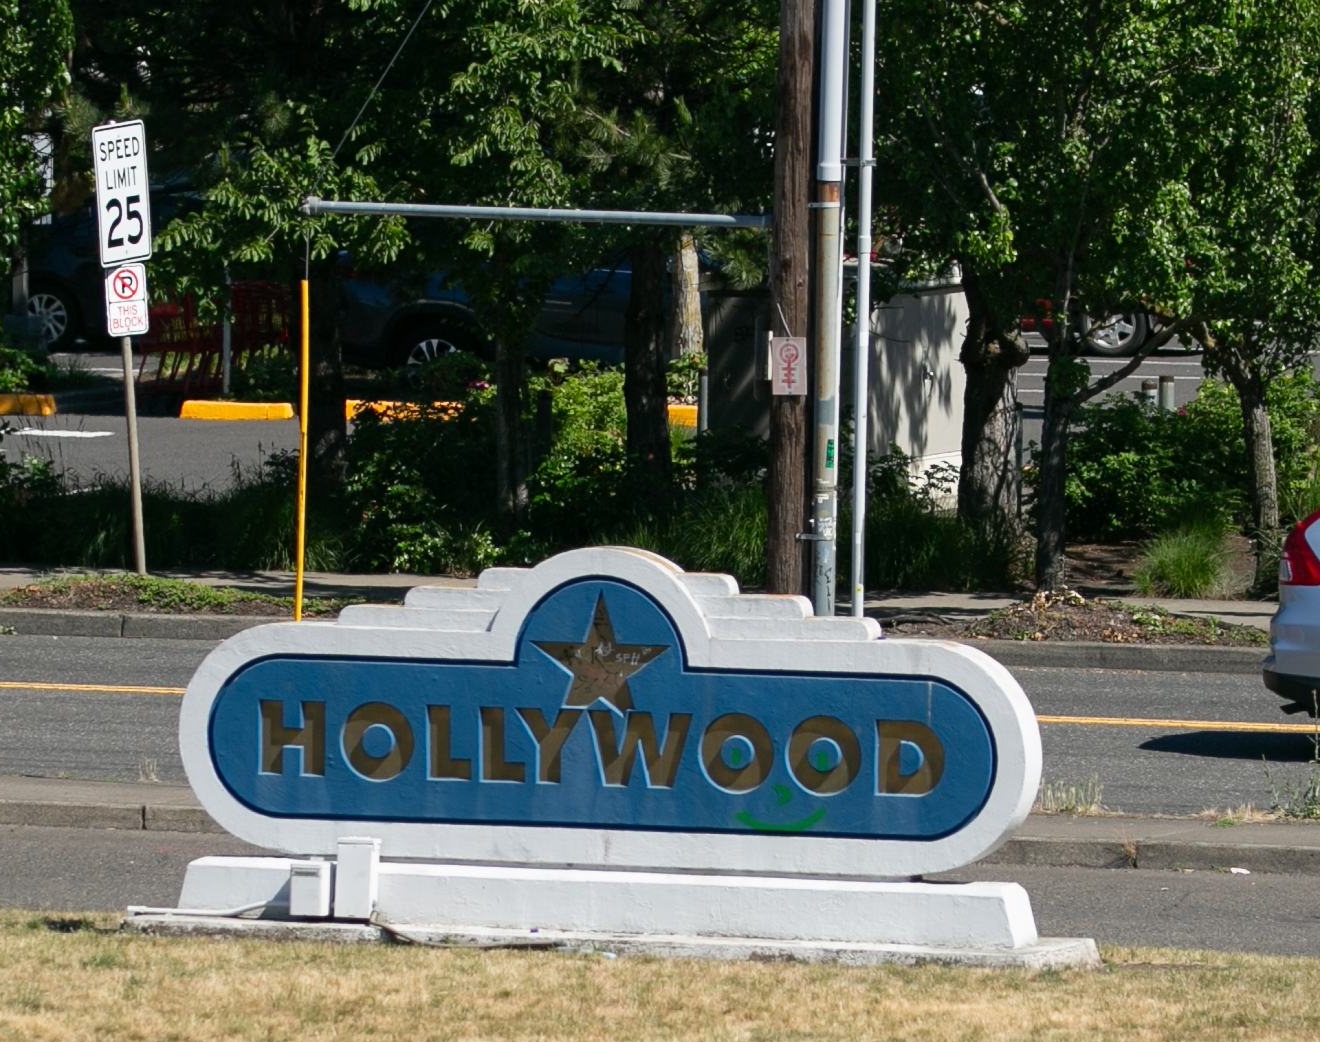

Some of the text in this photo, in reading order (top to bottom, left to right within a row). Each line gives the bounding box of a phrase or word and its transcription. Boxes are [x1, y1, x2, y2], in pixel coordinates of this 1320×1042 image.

[99, 136, 140, 162] SPEED
[105, 165, 137, 190] LIMIT
[105, 194, 144, 249] 25
[113, 316, 144, 329] BLOCK
[117, 304, 138, 316] THIS
[257, 699, 946, 798] HOLLYWOOD
